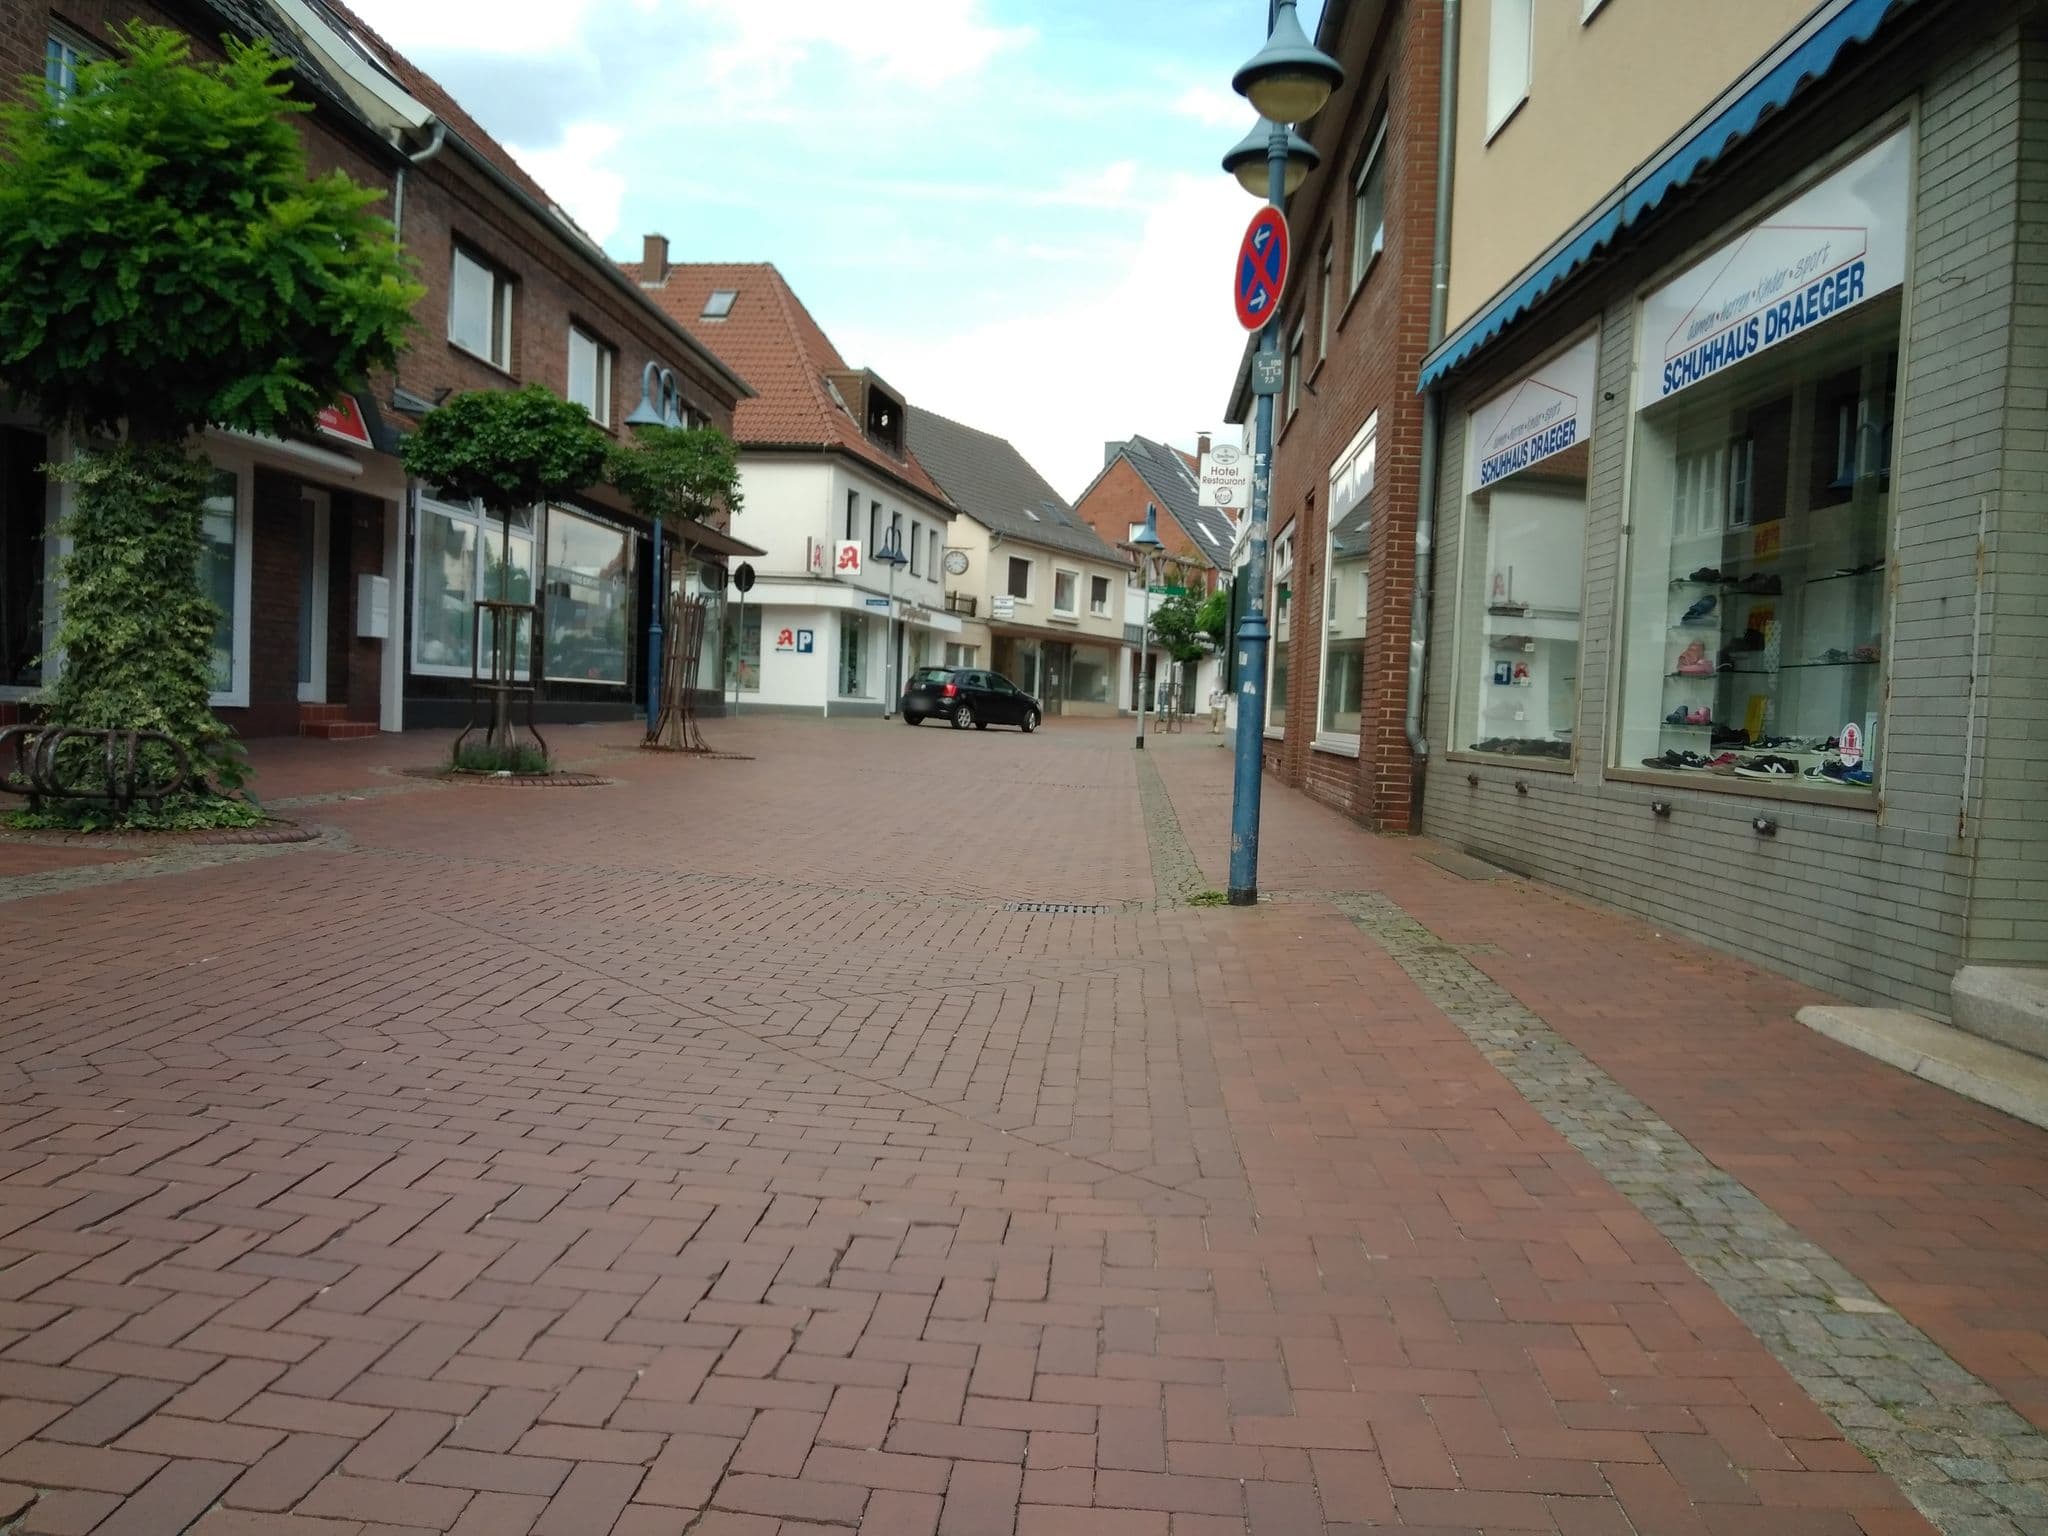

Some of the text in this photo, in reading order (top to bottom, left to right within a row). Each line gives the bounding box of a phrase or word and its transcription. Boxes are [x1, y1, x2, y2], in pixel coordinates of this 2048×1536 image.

[1663, 261, 1865, 395] SCHUHHAUS DRAEGER
[1481, 441, 1528, 485] SCHUHHAUS
[1530, 418, 1577, 463] DRAEGER
[1211, 467, 1239, 476] Hotel
[1202, 476, 1246, 486] Restaurant
[800, 632, 812, 650] P
